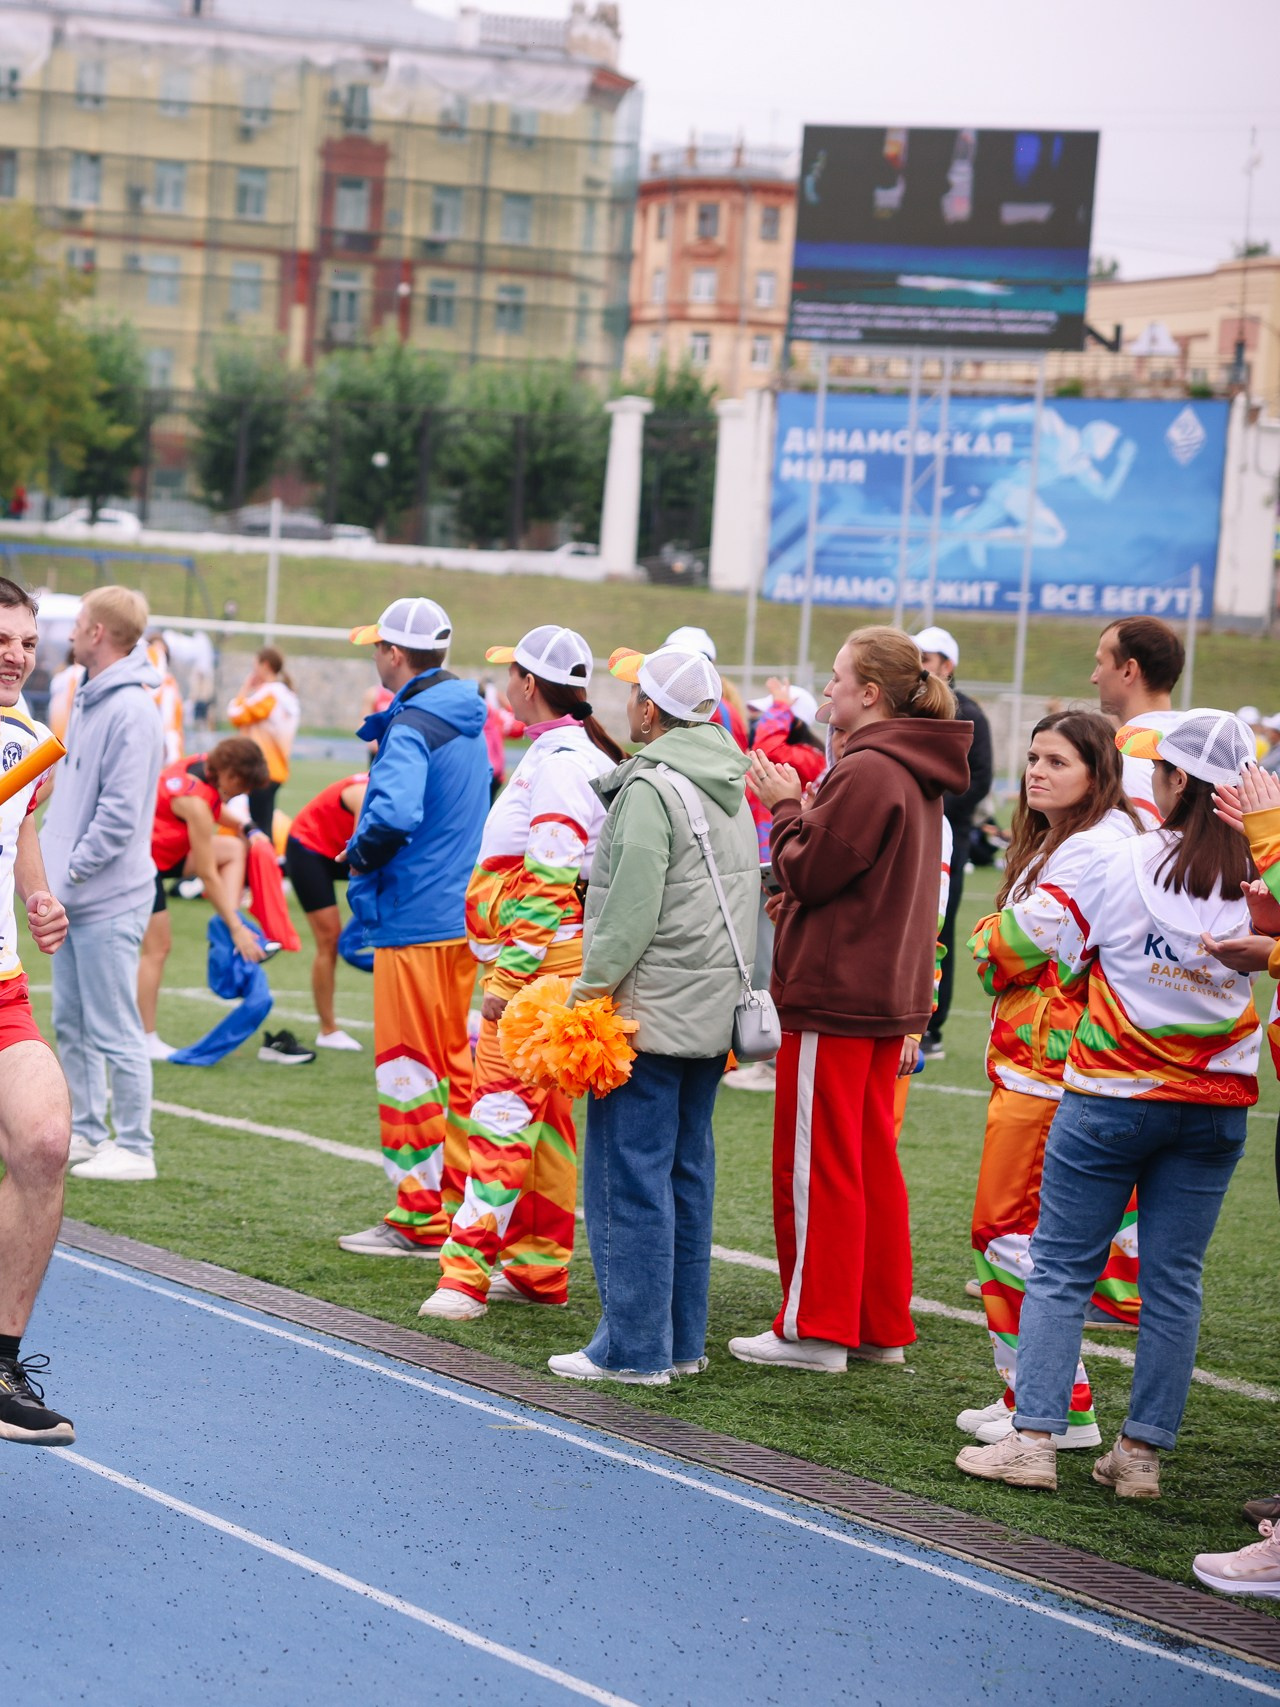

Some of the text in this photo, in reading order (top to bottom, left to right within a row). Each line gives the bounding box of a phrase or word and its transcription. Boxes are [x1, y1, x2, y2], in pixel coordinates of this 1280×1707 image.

[783, 428, 1014, 456] ДИНАМОВСКАЯ
[780, 457, 867, 483] МИЛЯ
[773, 574, 896, 603] ДИНАМО
[898, 579, 999, 607] БЕЖИТ
[1040, 583, 1096, 611] ВСЕ
